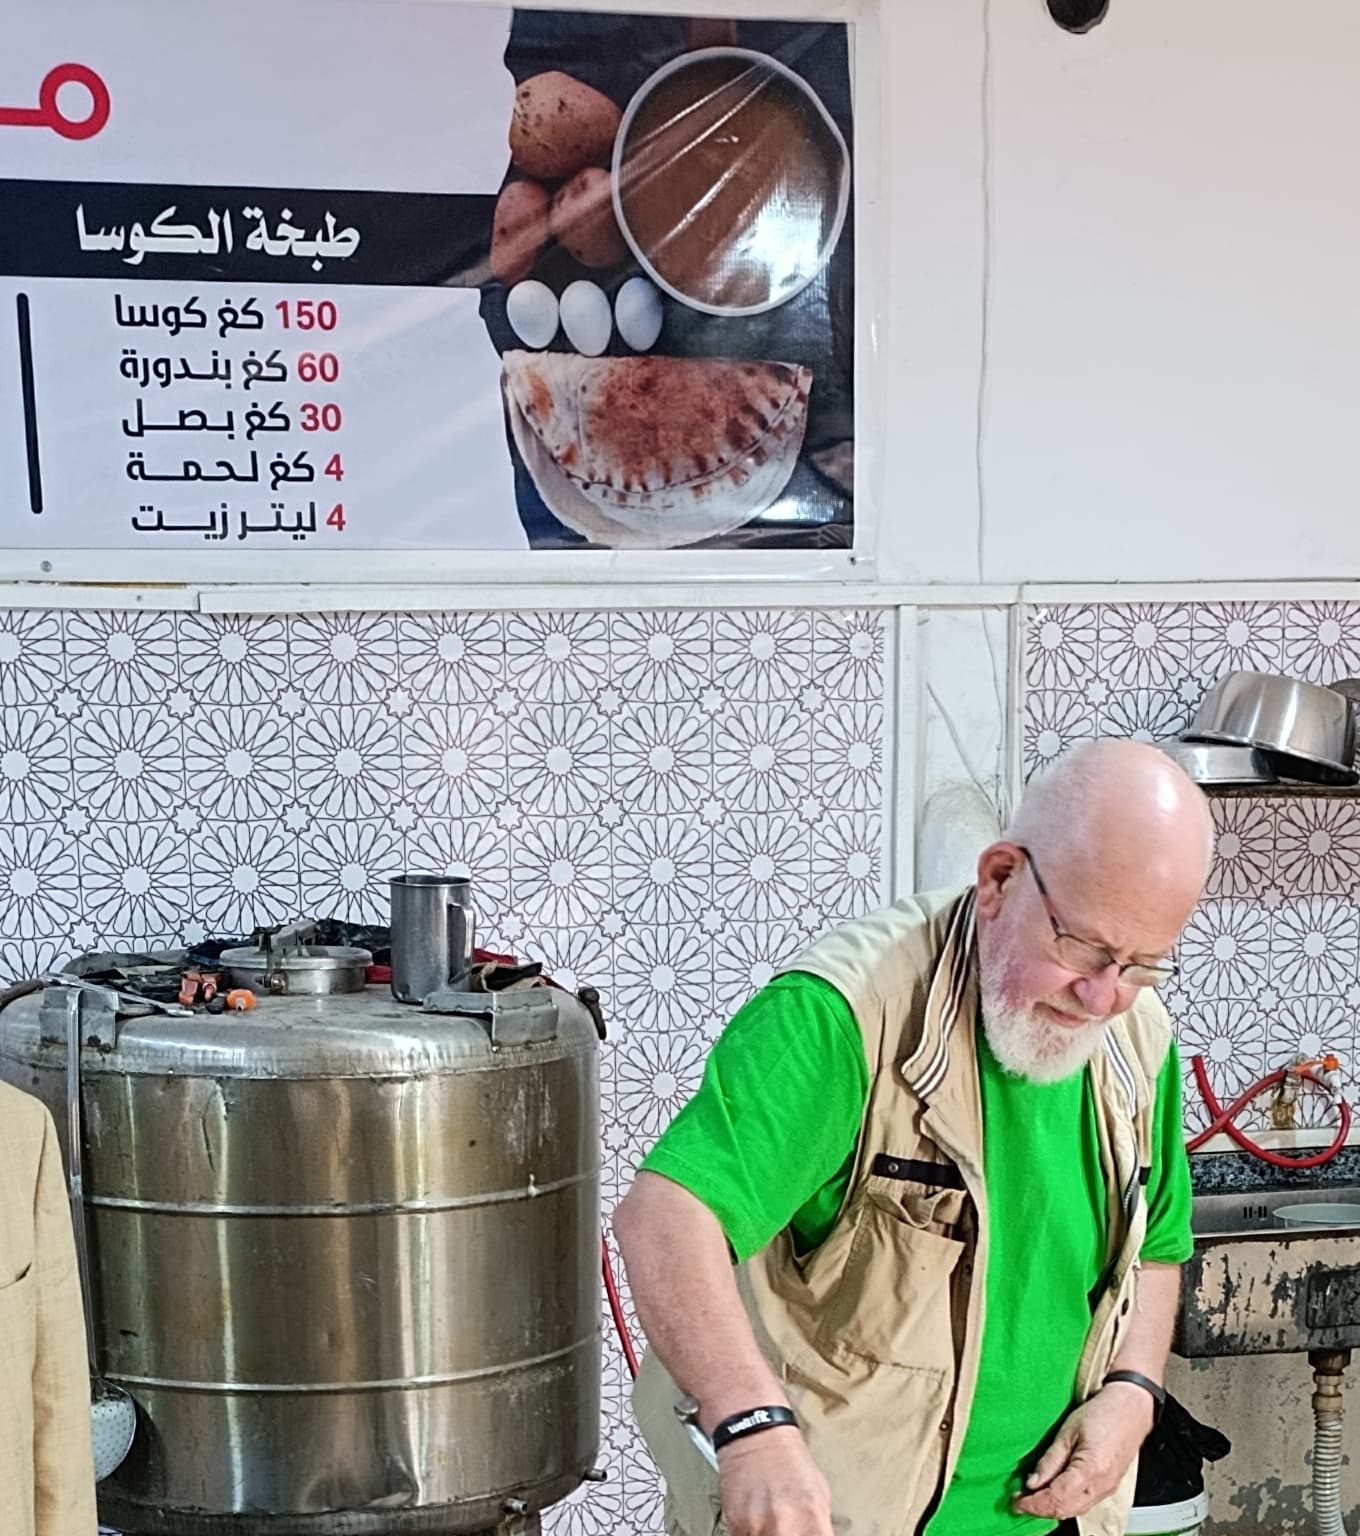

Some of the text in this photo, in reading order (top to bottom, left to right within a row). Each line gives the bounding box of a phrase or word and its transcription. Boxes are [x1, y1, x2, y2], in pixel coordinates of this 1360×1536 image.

[76, 203, 361, 272] طبخة الكوسا
[114, 293, 337, 338] 150 كغ كوسا
[119, 348, 339, 390] 60 كغ بندورة
[122, 398, 342, 440] 30 كغ بصل
[126, 450, 344, 490] 4 كغ لحمة
[326, 504, 346, 532] 4
